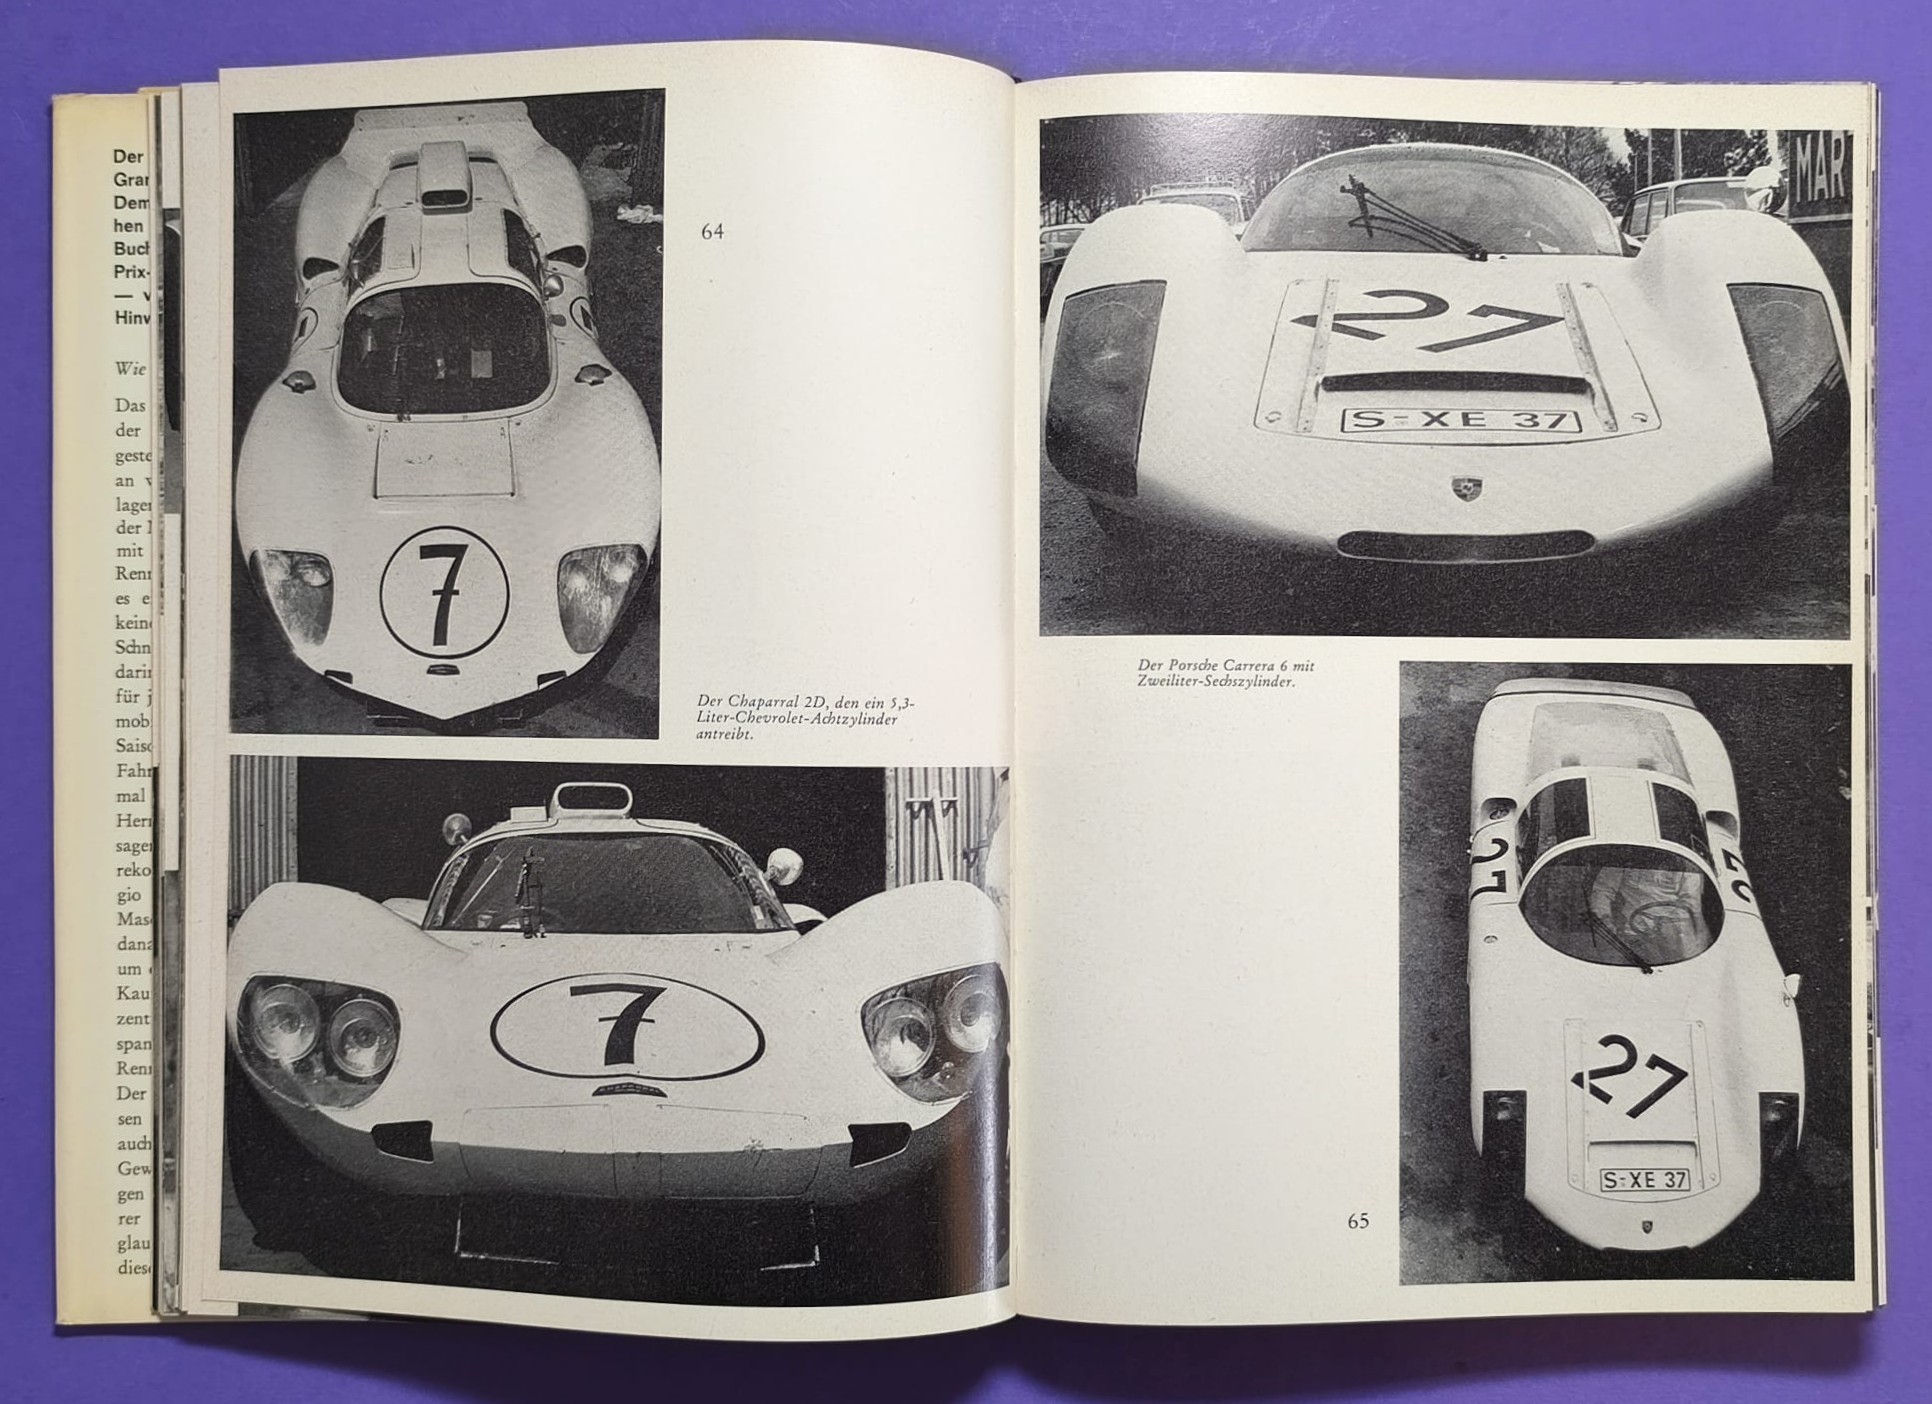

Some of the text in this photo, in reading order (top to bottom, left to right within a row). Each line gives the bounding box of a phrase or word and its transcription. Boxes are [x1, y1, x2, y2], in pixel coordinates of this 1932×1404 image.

[114, 149, 144, 163] Der
[114, 218, 143, 232] hen
[702, 223, 724, 239] 64
[1290, 288, 1565, 353] 27
[116, 362, 146, 375] Wie
[115, 398, 145, 412] Das
[1513, 412, 1568, 430] 37
[116, 422, 141, 437] der
[116, 478, 134, 487] an
[116, 520, 142, 534] der
[117, 543, 143, 557] mit
[116, 595, 130, 605] es
[419, 544, 469, 646] 7
[116, 638, 152, 654] Schn
[1138, 658, 1314, 672] Der Porsche Carrera 6 mit
[1138, 674, 1295, 690] Zweiliter-Sechszylinder.
[116, 688, 140, 703] für
[697, 694, 914, 711] Der Chaparral 2D, den ein 5,3-
[697, 710, 898, 728] Liter-Chevrolet-Achtzylinder
[696, 726, 753, 740] antreibt.
[117, 788, 145, 802] mal
[116, 861, 150, 877] reko
[118, 887, 141, 905] gio
[118, 966, 141, 975] um
[117, 986, 152, 1000] Kau
[117, 1015, 152, 1027] zent
[569, 983, 668, 1067] 7
[117, 1041, 152, 1054] span
[1570, 1034, 1688, 1119] 27
[117, 1086, 147, 1100] Der
[118, 1116, 141, 1125] sen
[117, 1135, 151, 1150] auch
[117, 1160, 151, 1176] Gew
[1664, 1171, 1686, 1189] 37
[118, 1191, 144, 1204] gen
[119, 1216, 140, 1225] rer
[1348, 1213, 1369, 1229] 65
[118, 1235, 150, 1253] glau
